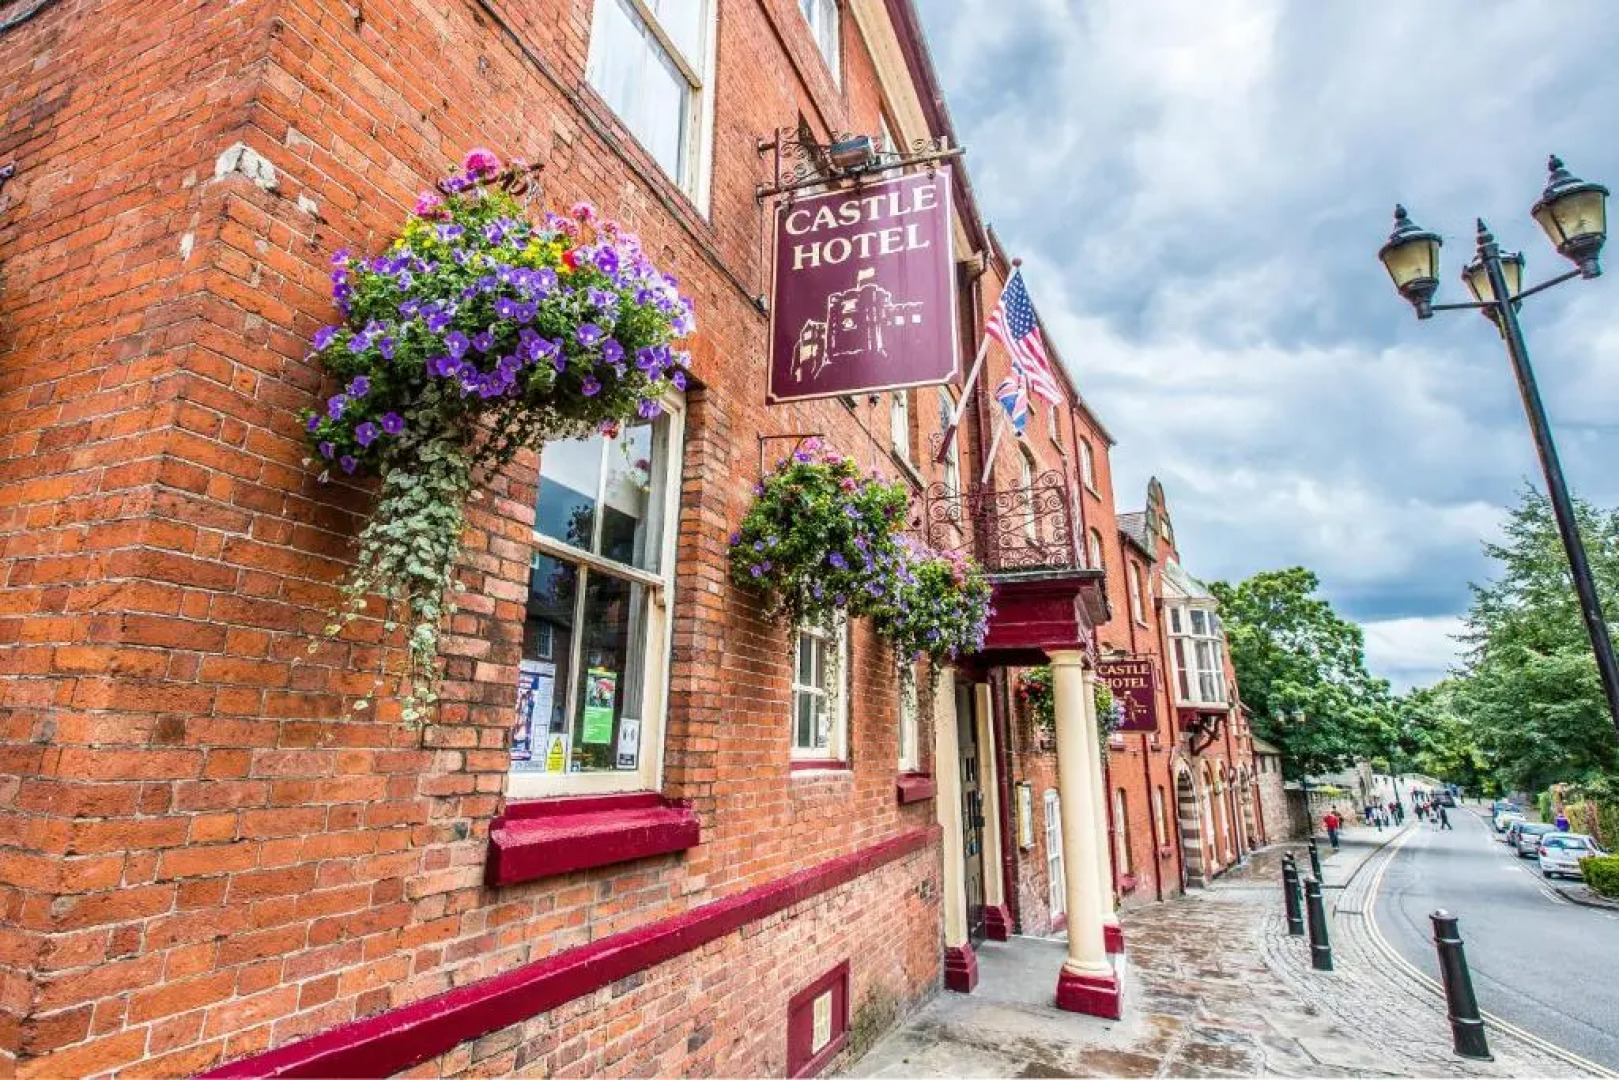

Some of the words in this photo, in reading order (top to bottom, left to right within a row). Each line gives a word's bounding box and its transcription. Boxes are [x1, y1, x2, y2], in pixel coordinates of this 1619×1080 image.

[785, 184, 938, 235] CASTLE
[792, 223, 931, 270] HOTEL
[1098, 664, 1150, 675] CASTLE
